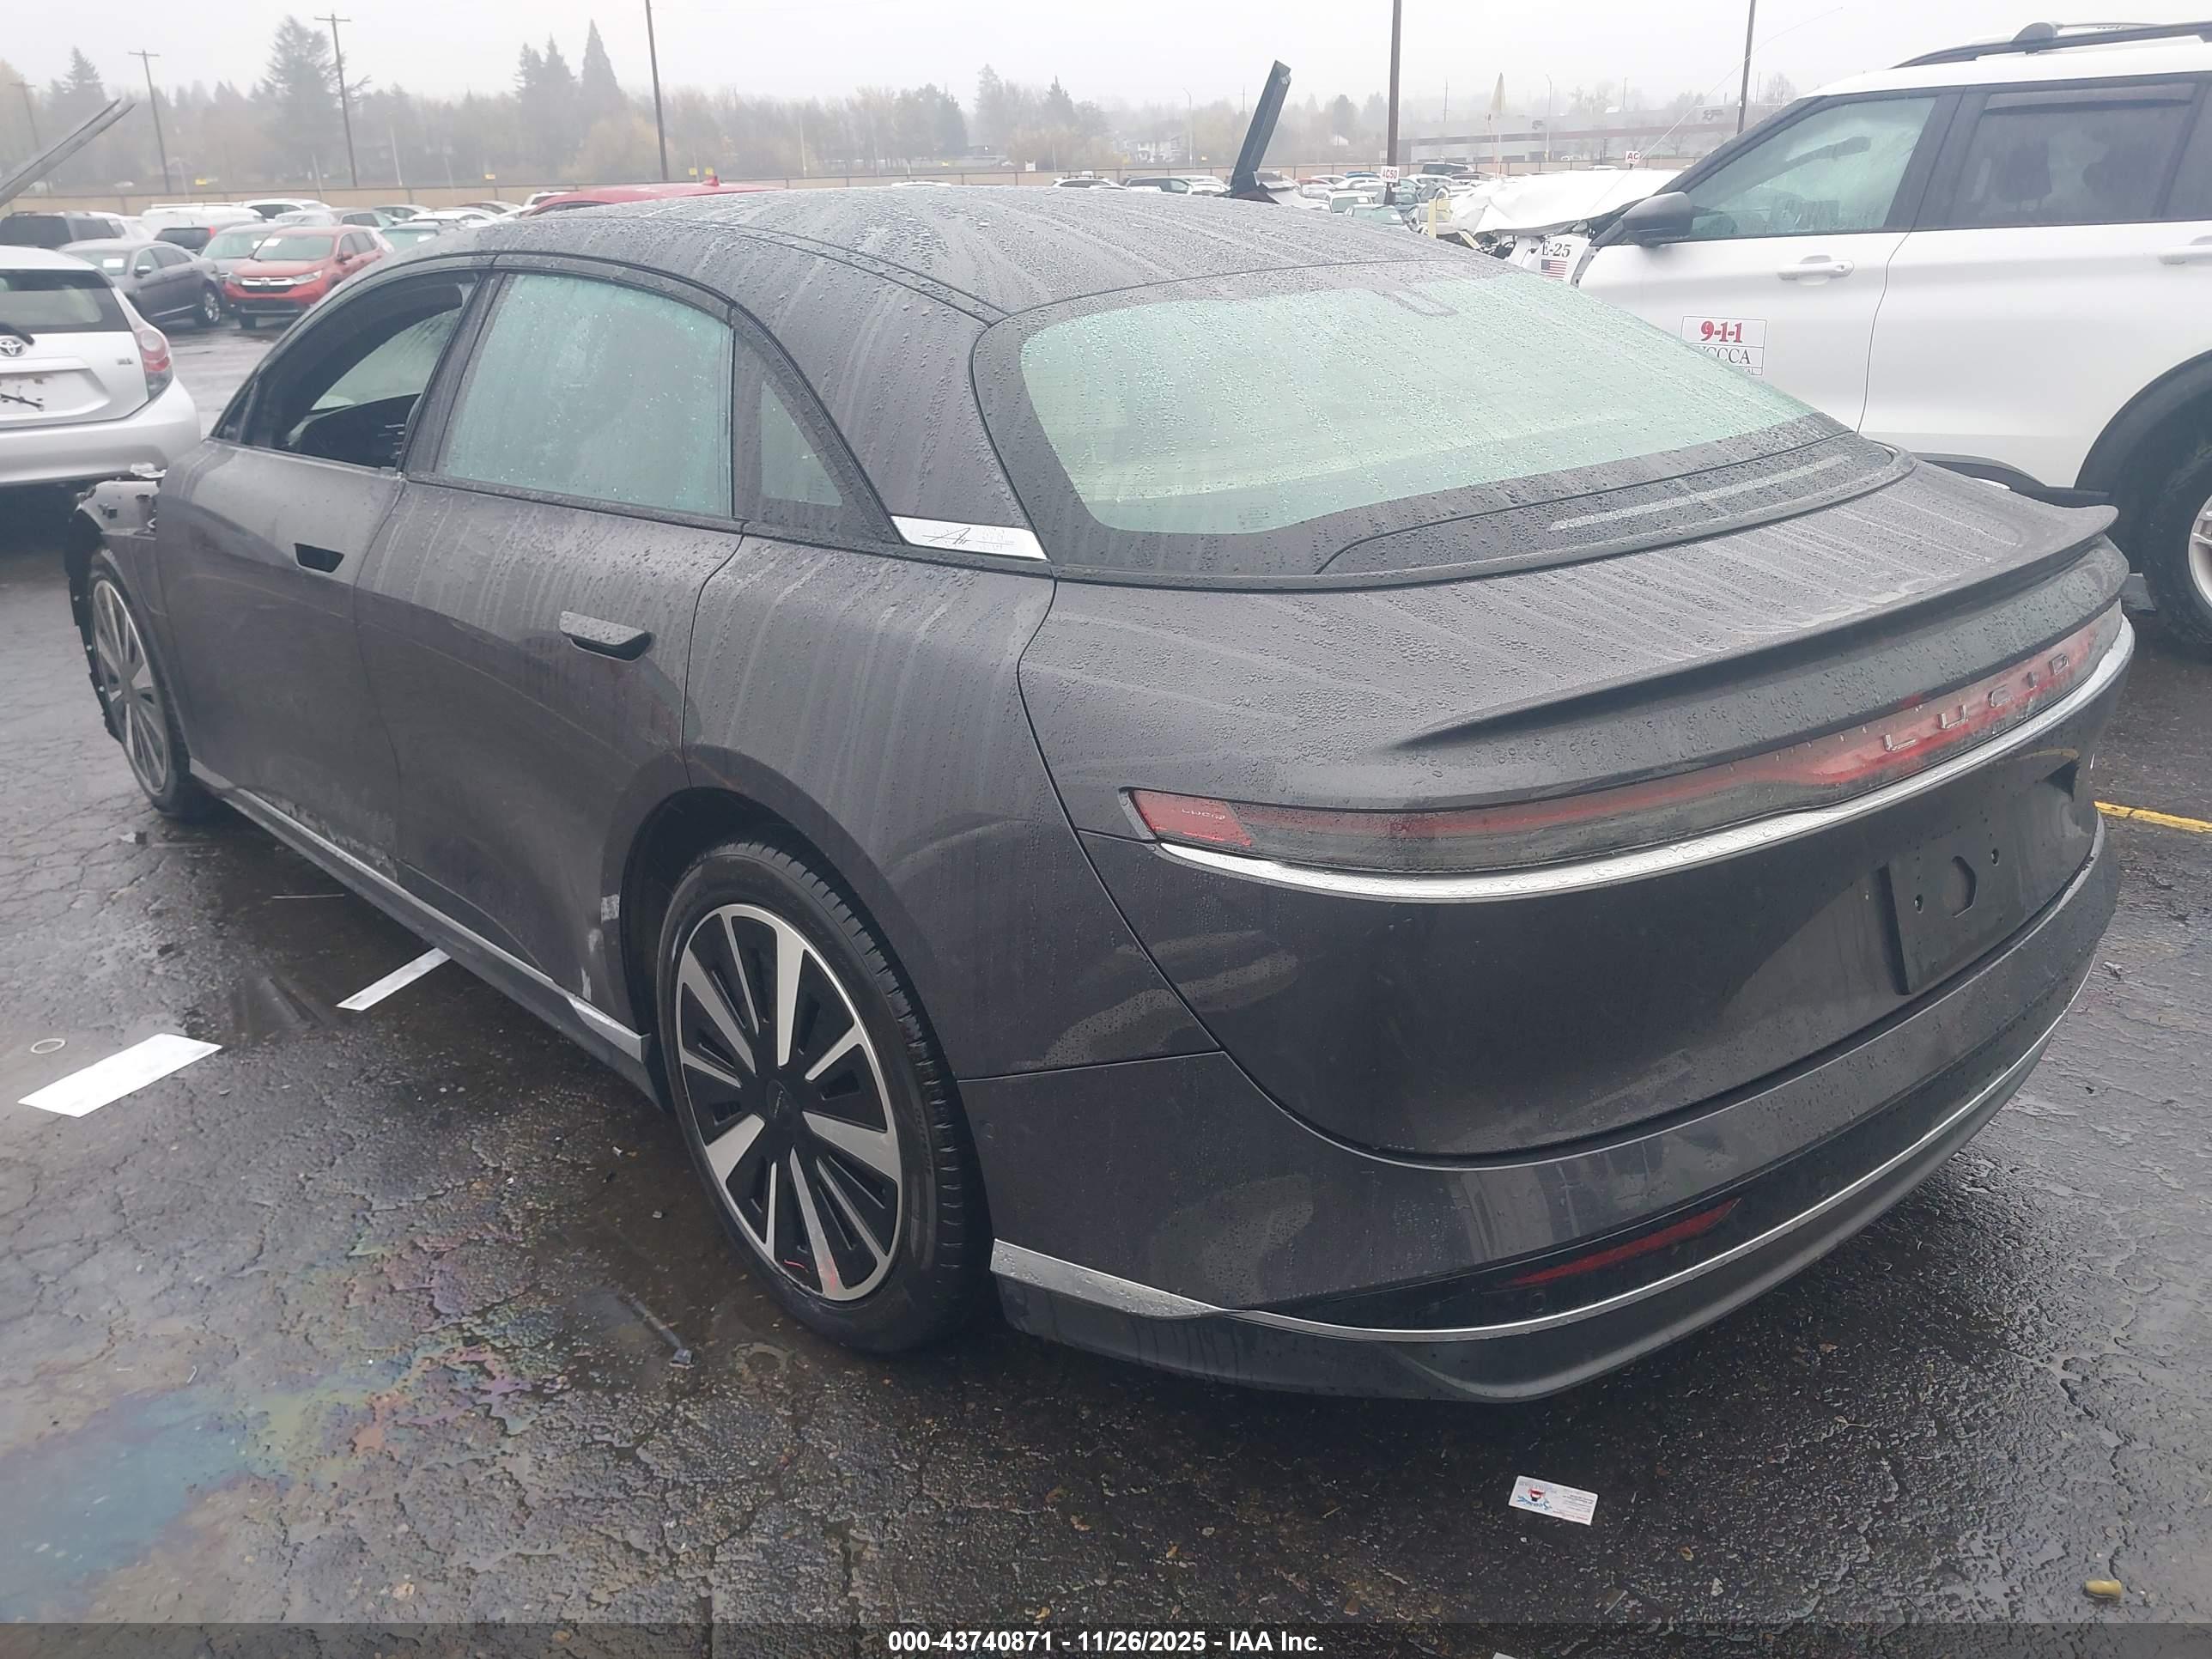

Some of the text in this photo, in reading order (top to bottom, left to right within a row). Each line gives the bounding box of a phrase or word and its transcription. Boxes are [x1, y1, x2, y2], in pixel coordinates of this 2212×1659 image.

[1540, 240, 1571, 258] E-25
[1700, 320, 1743, 343] 9-1-1
[1883, 653, 2069, 752] LUCID
